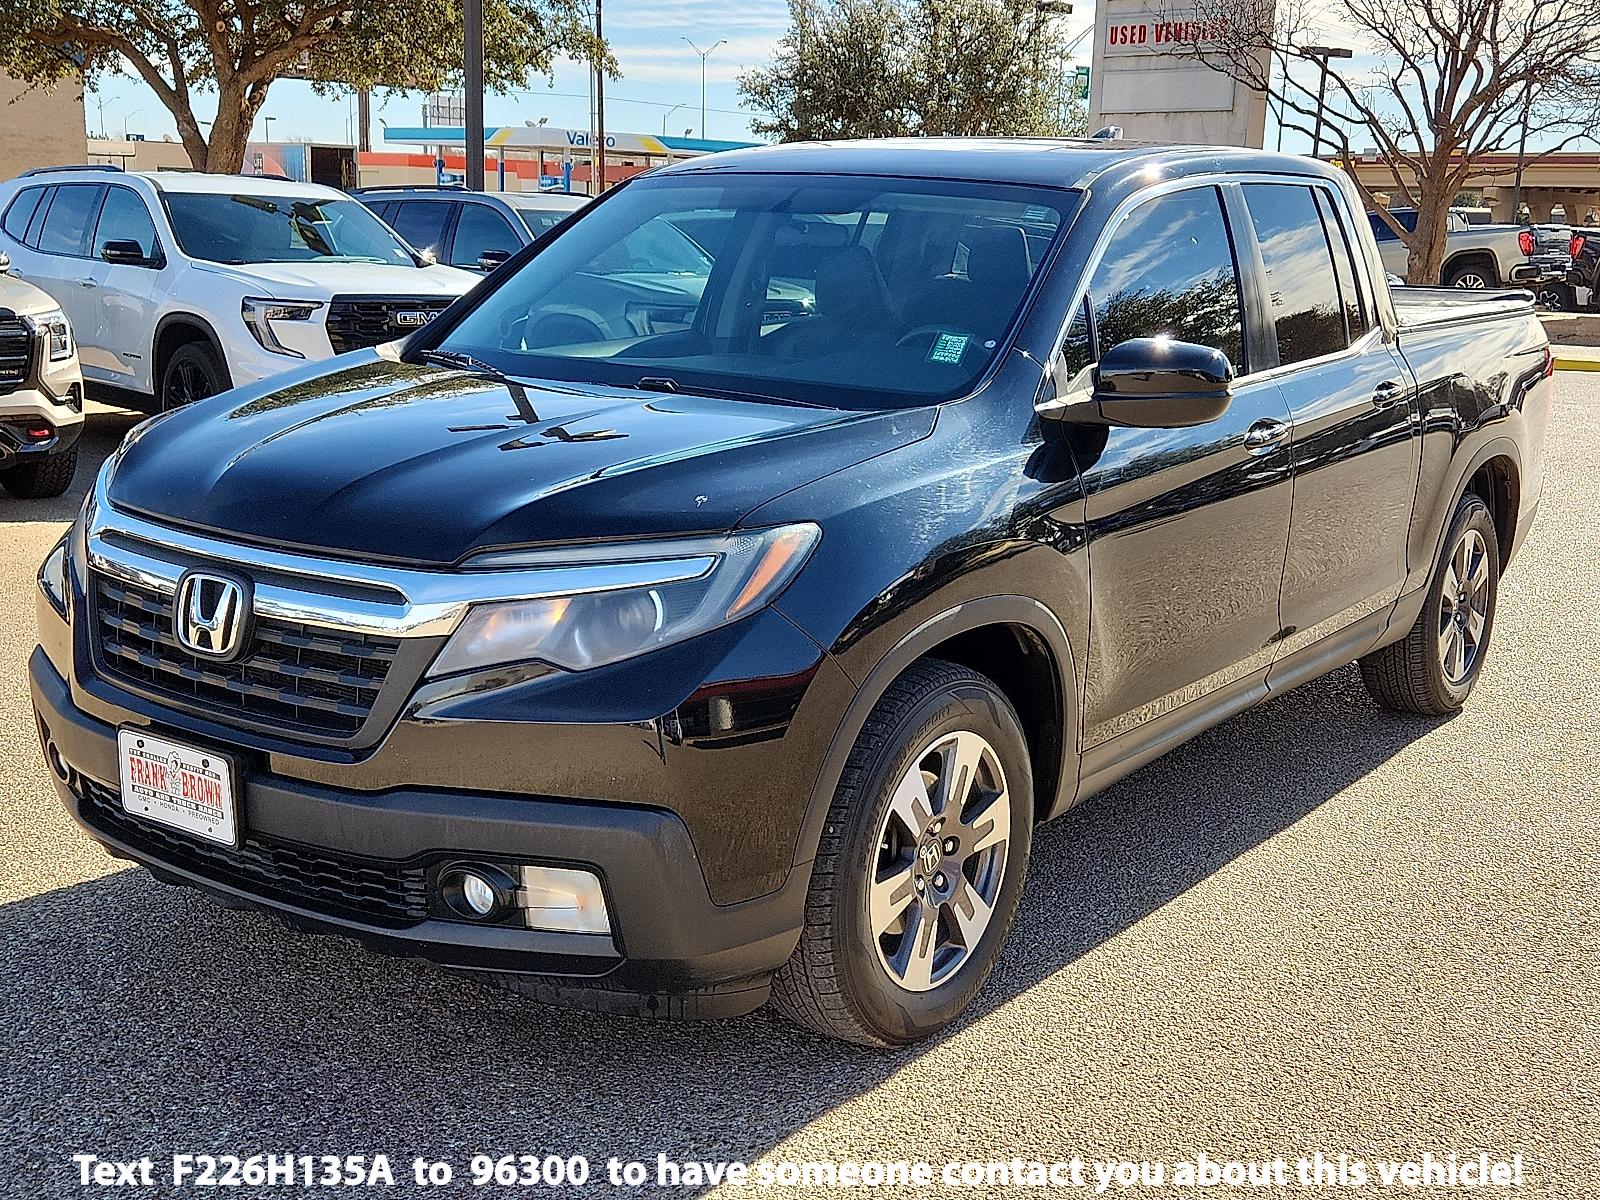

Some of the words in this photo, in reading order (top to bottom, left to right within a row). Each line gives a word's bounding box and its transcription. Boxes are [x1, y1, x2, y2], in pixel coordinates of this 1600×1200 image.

[1109, 24, 1147, 45] USED
[566, 130, 616, 148] Valeo
[130, 757, 169, 792] FRANK
[181, 771, 223, 809] BROWN
[134, 785, 155, 797] AUTO
[155, 791, 171, 801] AND
[171, 795, 198, 810] TRUCK
[198, 804, 223, 819] RANCH
[137, 795, 151, 804] GMC
[159, 801, 181, 813] HONDA
[187, 810, 221, 826] PREOWNED
